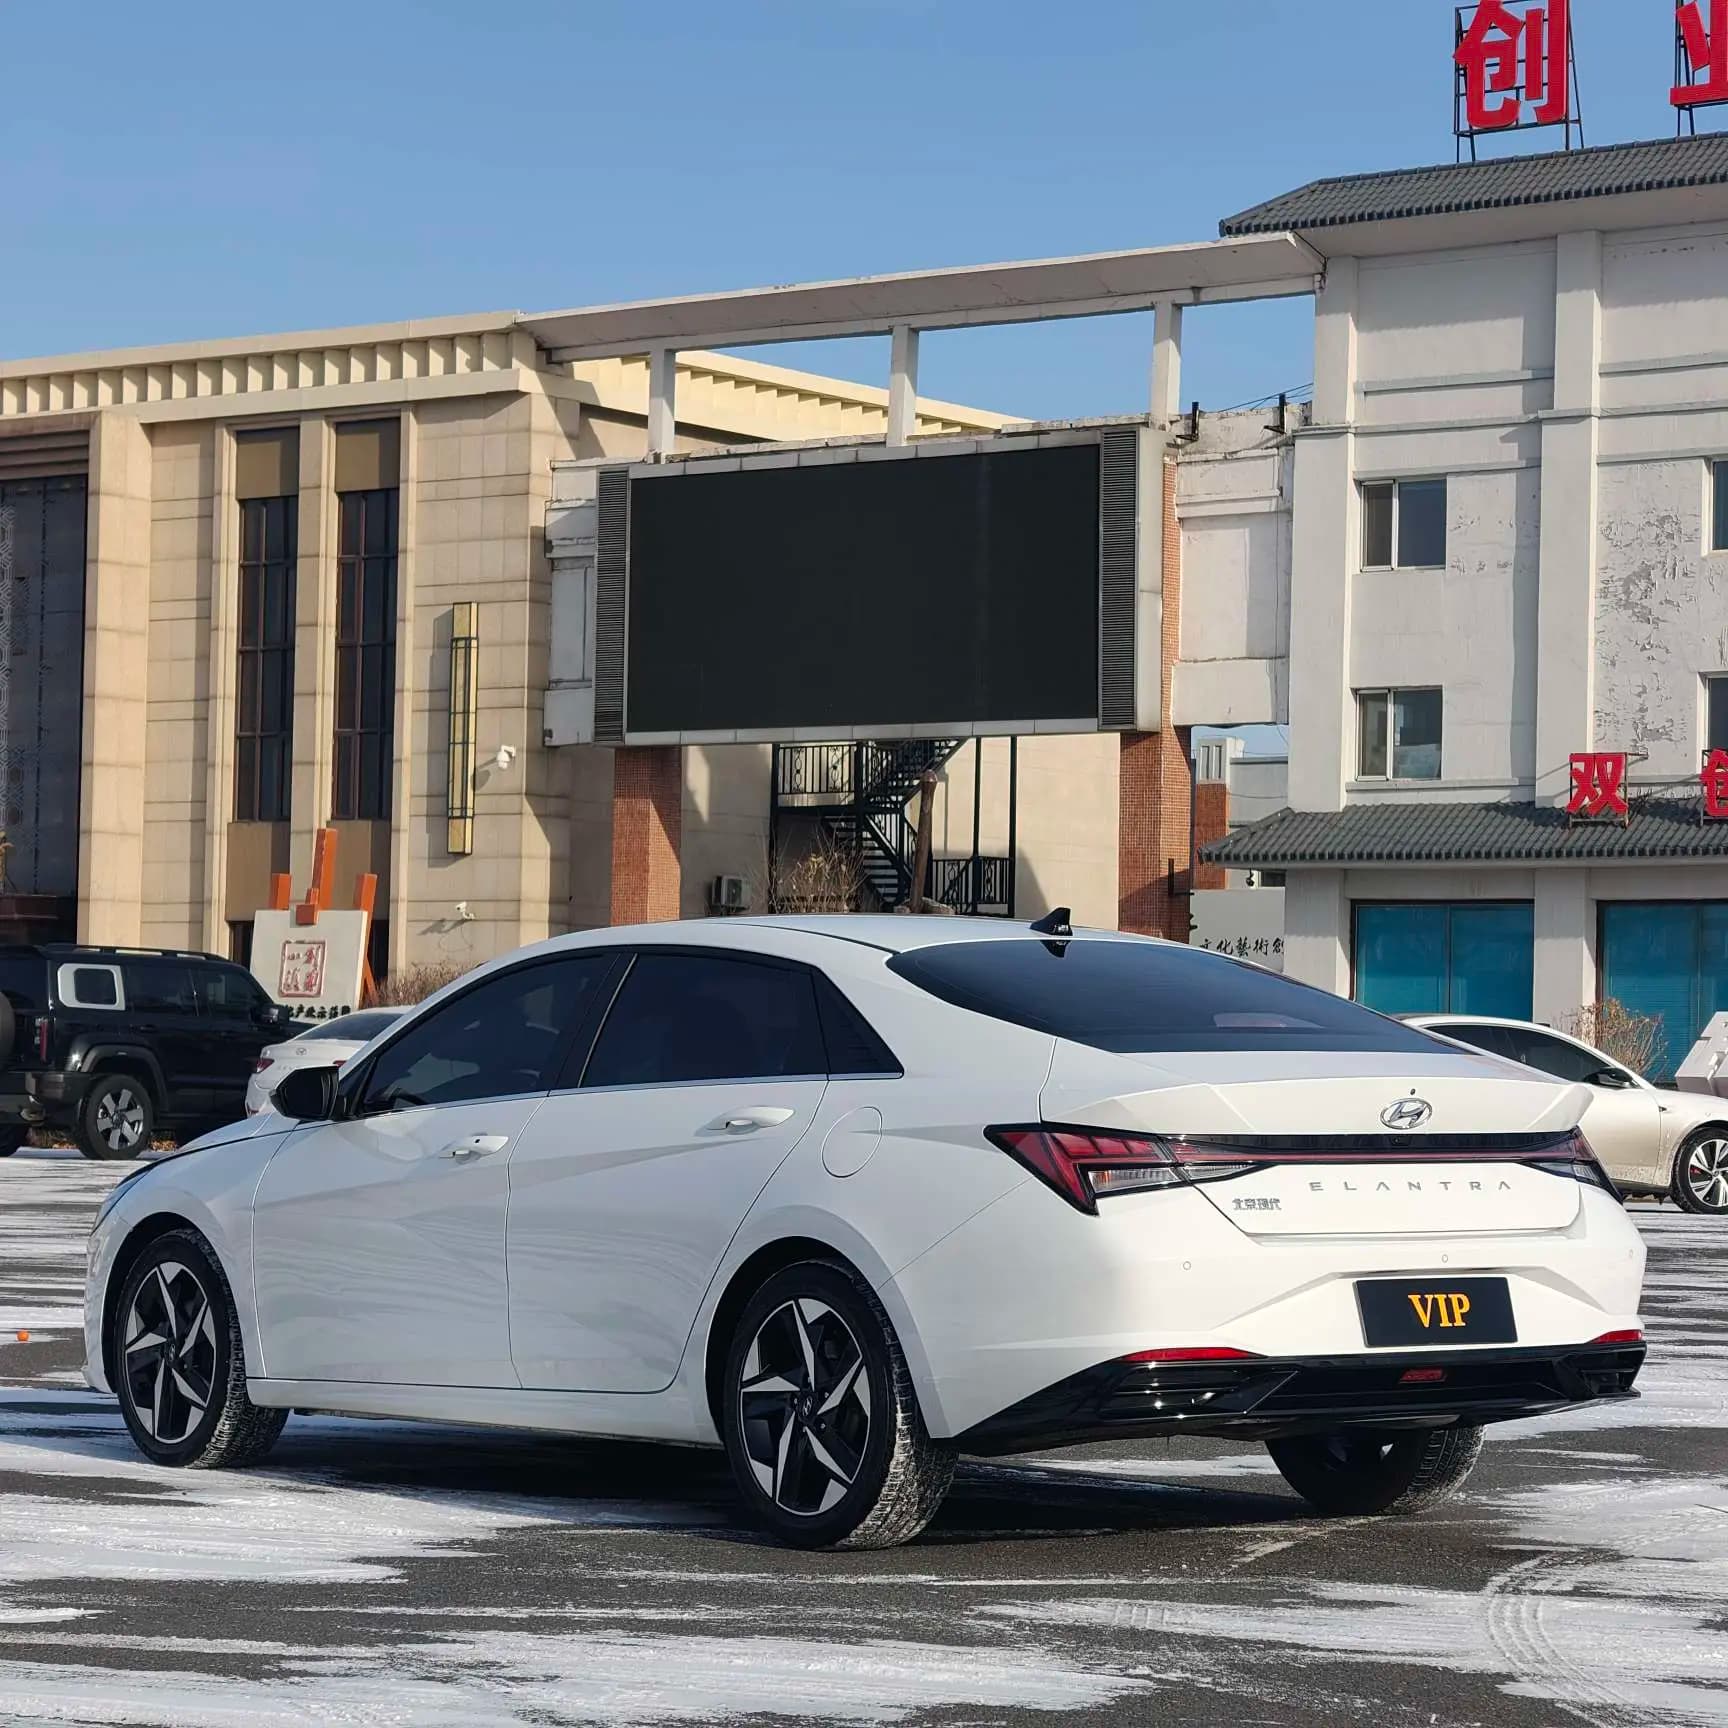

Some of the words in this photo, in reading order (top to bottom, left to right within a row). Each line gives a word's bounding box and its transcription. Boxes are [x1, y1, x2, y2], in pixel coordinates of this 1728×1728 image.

[1309, 1181, 1511, 1192] ELANTRA
[1232, 1198, 1282, 1211] 北京现代
[1408, 1293, 1471, 1328] VIP
